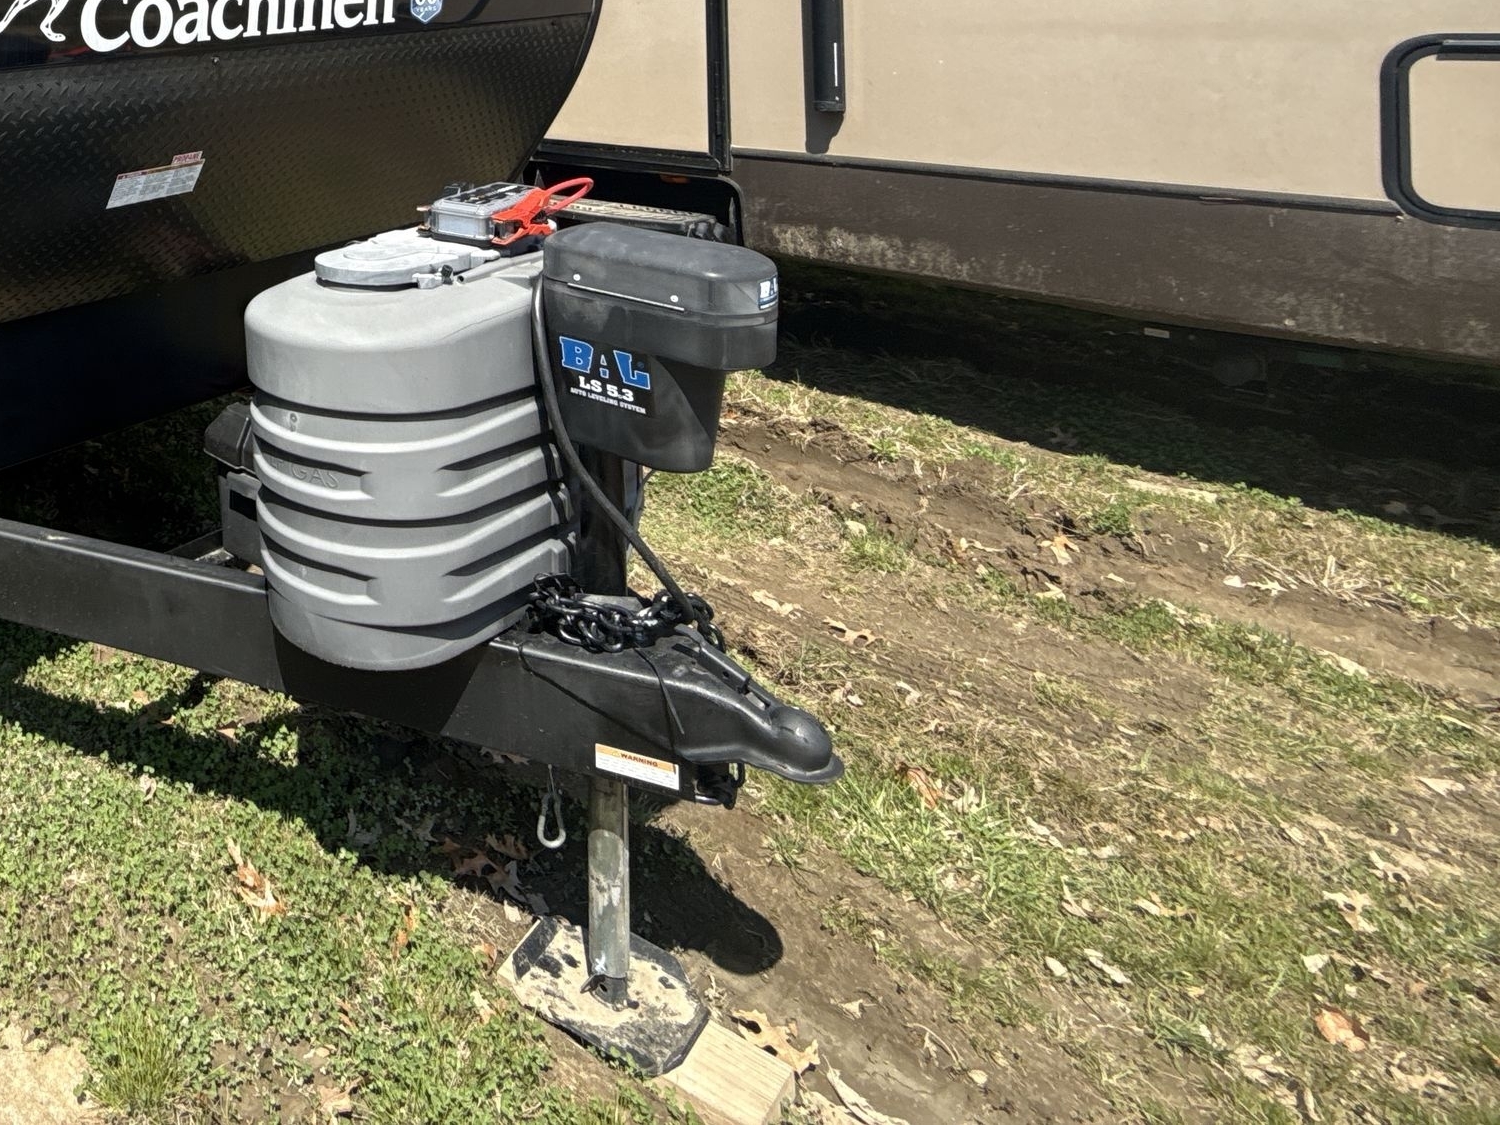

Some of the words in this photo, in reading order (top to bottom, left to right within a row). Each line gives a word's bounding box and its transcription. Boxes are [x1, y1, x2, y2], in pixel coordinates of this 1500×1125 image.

[414, 5, 437, 13] YEARS
[579, 375, 602, 393] LS
[606, 384, 634, 402] 5.3
[570, 387, 587, 397] AUTO
[588, 391, 619, 407] LEVELING
[620, 401, 647, 415] SYSTEM
[620, 753, 658, 768] WARNING
